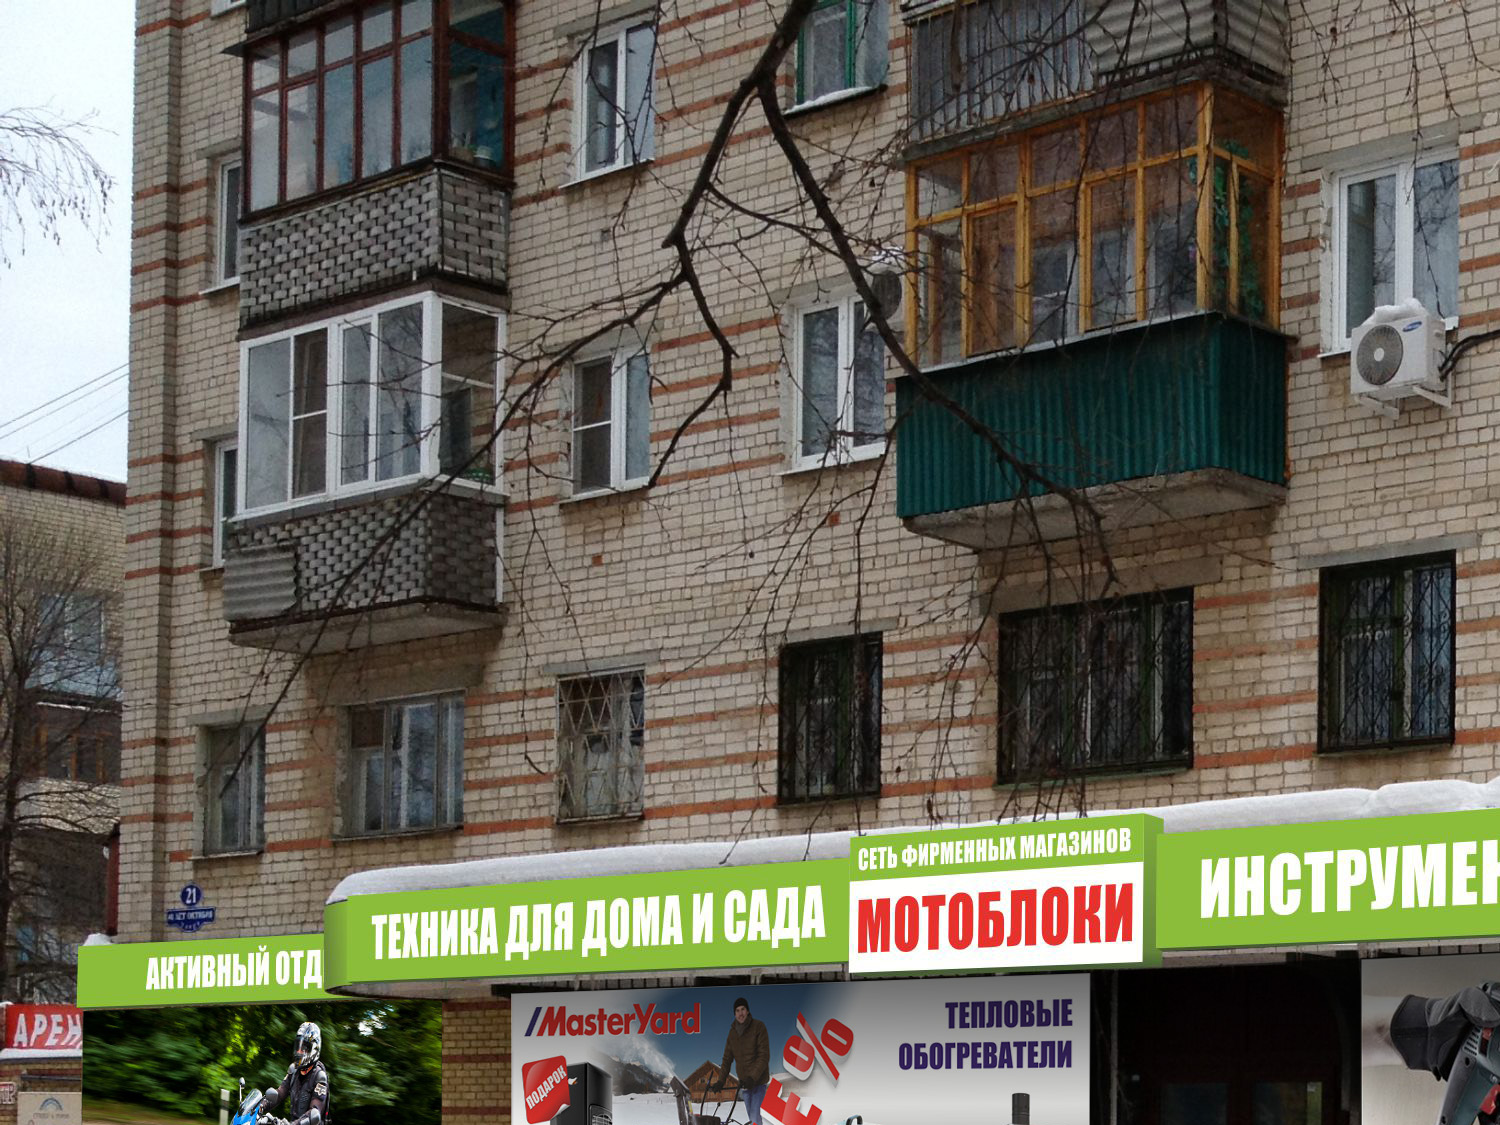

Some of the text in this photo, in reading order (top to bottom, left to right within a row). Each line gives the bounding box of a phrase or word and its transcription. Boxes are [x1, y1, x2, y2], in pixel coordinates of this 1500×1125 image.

[858, 827, 1132, 871] СЕТЬ ФИРМЕННЫХ МАГАЗИНОВ
[185, 887, 197, 904] 21
[371, 885, 826, 961] ТЕХНИКА ДЛЯ ДОМА И САДА
[857, 883, 1133, 954] МОТОБЛОКИ
[145, 944, 323, 990] АКТИВНЫЙ ОТД
[13, 1013, 82, 1048] АРЕН
[536, 1002, 701, 1036] MasterYard
[945, 998, 1073, 1029] ТЕПЛОВЫЕ
[898, 1040, 1072, 1071] ОБОГРЕВАТЕЛИ
[525, 1065, 567, 1110] ПОДАРОК
